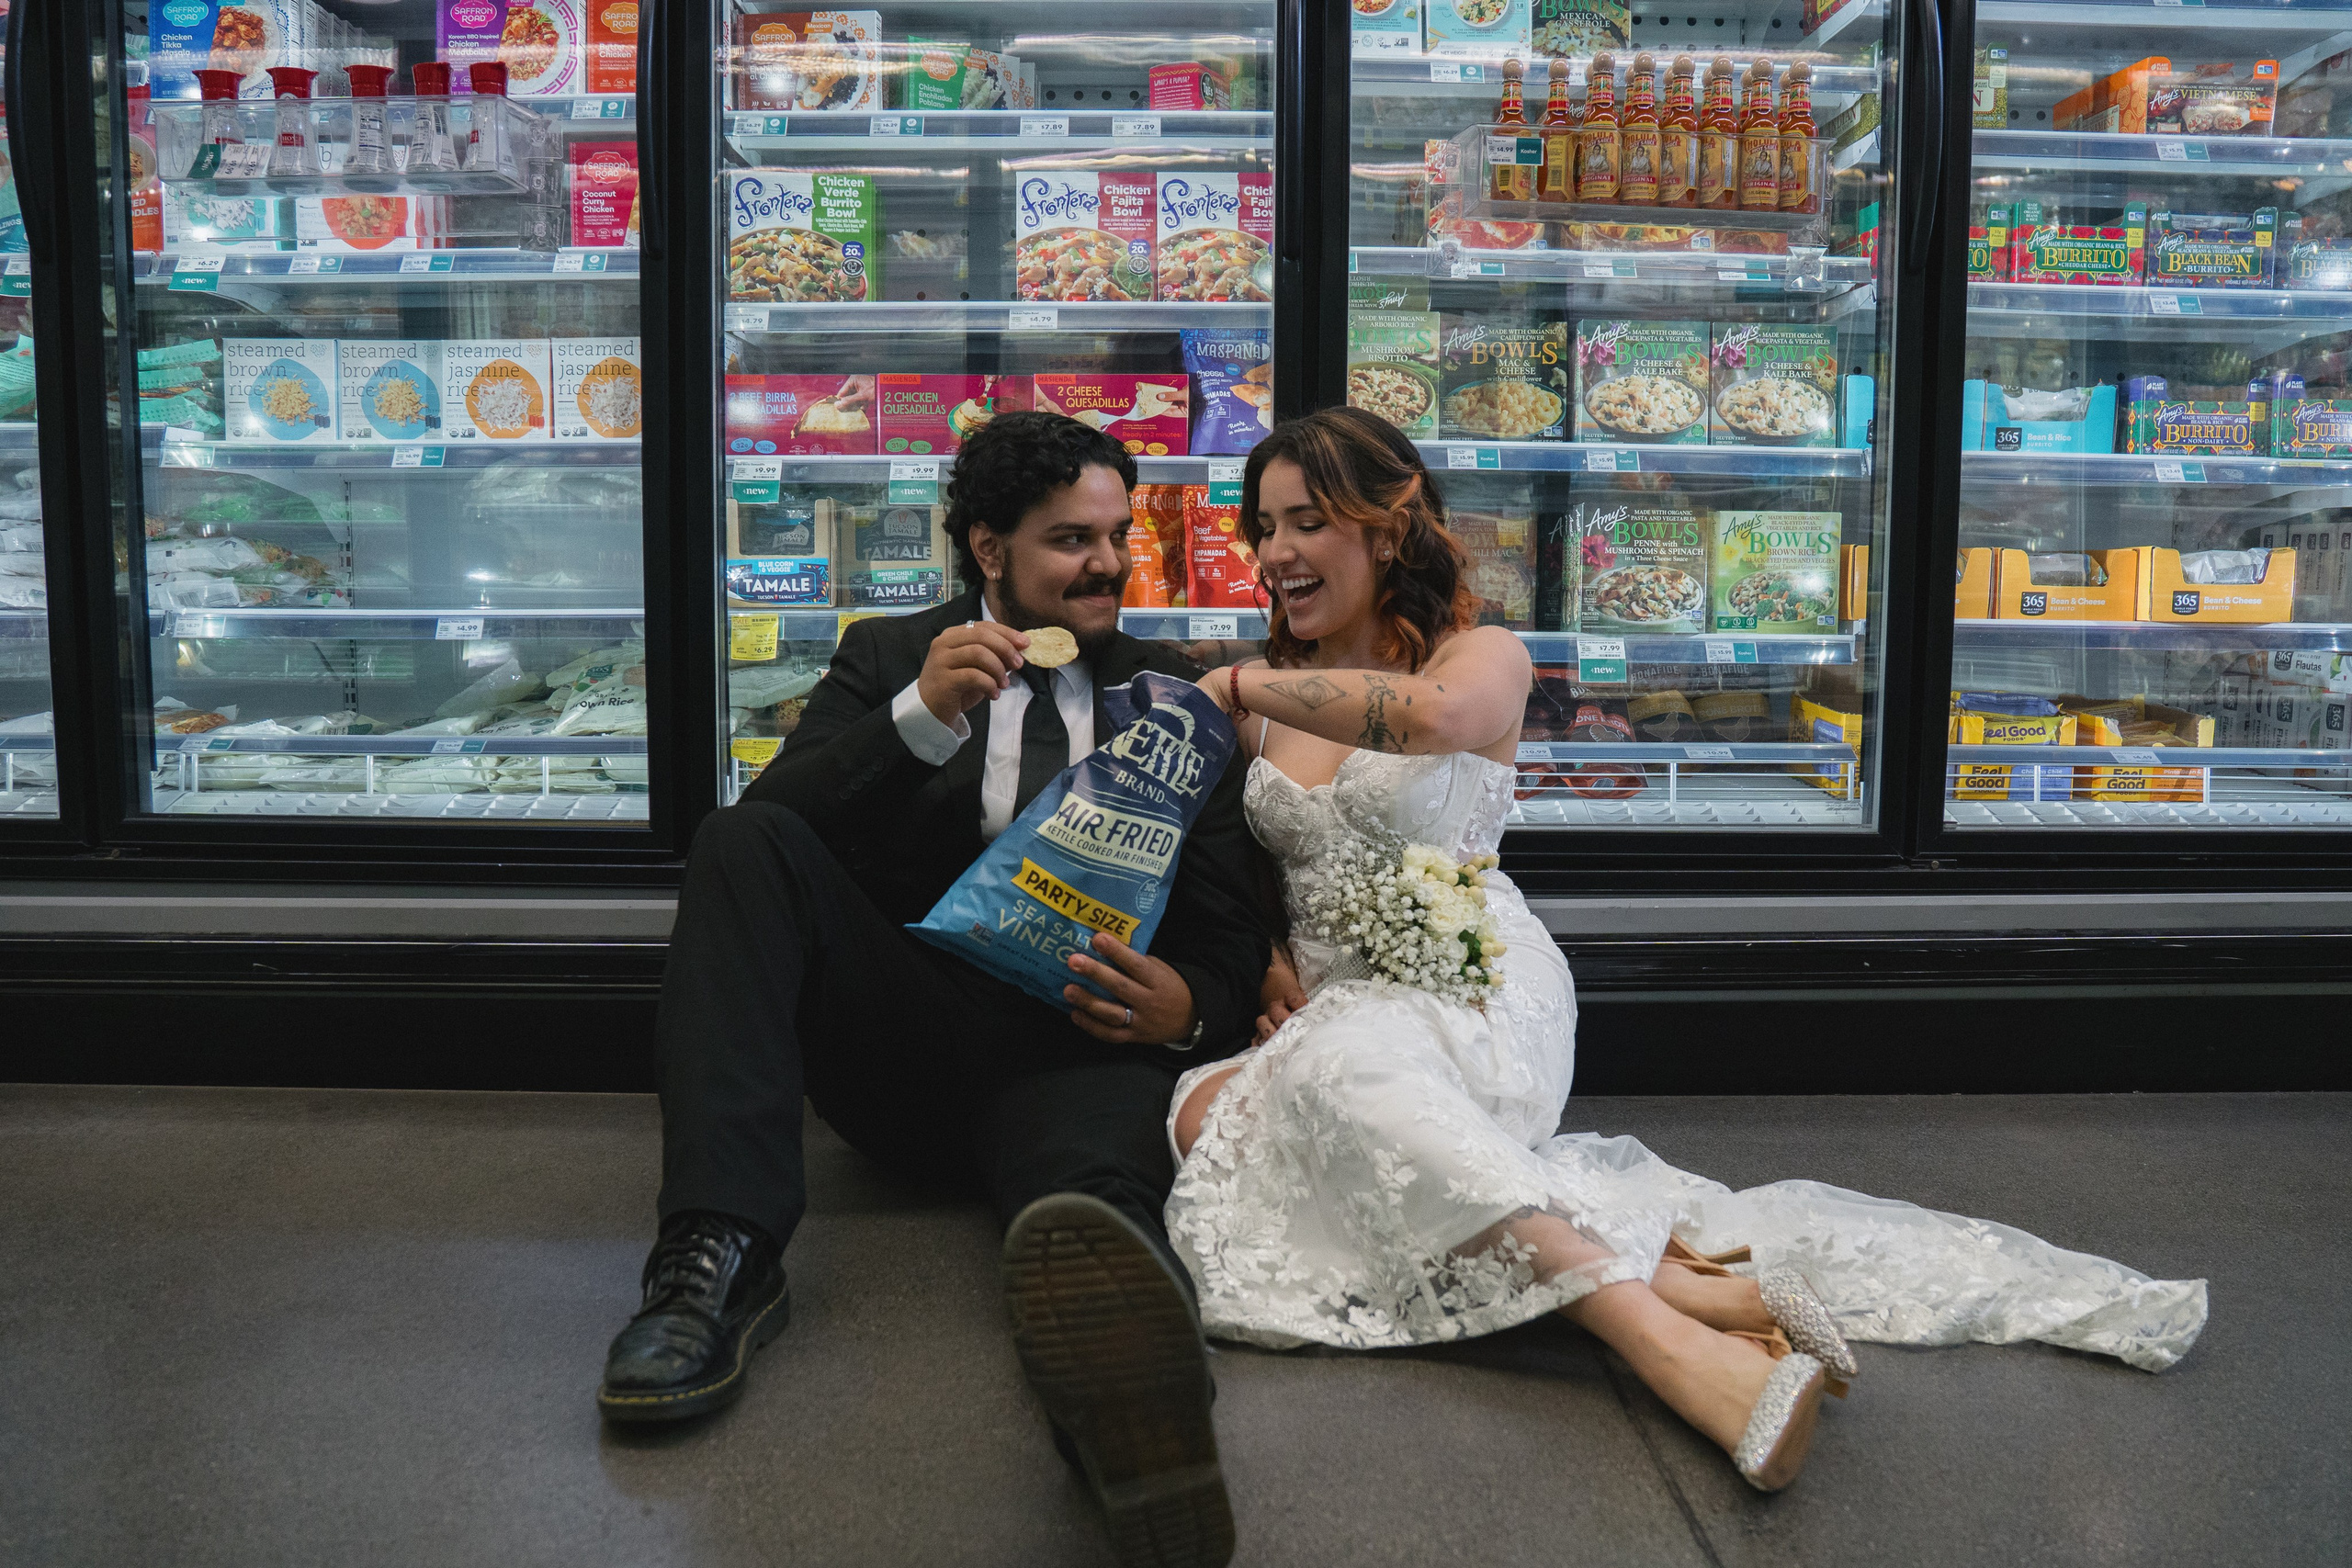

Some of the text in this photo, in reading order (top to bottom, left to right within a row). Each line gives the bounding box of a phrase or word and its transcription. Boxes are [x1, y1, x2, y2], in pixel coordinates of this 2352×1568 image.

[166, 6, 205, 15] SAFFRON
[455, 6, 493, 15] SAFFRON
[755, 33, 793, 41] SAFFRON
[923, 60, 956, 68] SAFFRON
[930, 67, 949, 75] ROAD
[919, 84, 944, 94] Chicken
[919, 92, 953, 103] Enchiladas
[2150, 88, 2181, 110] Amy's
[2181, 90, 2256, 100] VIETNAMESE
[919, 99, 944, 108] Poblano
[594, 170, 618, 178] ROAD
[819, 176, 865, 187] Chicken
[824, 187, 859, 197] Verde
[1104, 186, 1150, 195] Chicken
[821, 197, 862, 208] Burrito
[1111, 196, 1143, 207] Fajita
[827, 208, 856, 218] Bowl
[1113, 207, 1141, 217] Bowl
[2030, 230, 2056, 249] Amy's
[2157, 234, 2185, 254] Amy's
[2041, 248, 2125, 268] BURRITO
[2168, 254, 2251, 273] BLACK BEAN
[1443, 325, 1486, 356] Amy's
[1588, 322, 1629, 354] Amy's
[228, 342, 305, 357] steamed
[447, 343, 522, 358] steamed
[1470, 342, 1557, 365] BOWLS
[1615, 342, 1700, 366] BOWLS
[230, 361, 287, 377] brown
[449, 362, 520, 381] jasmine
[229, 381, 263, 396] rice
[447, 381, 480, 397] rice
[1057, 386, 1102, 397] 2 CHEESE
[885, 392, 938, 402] 2 CHICKEN
[1066, 397, 1129, 408] QUESADILLAS
[884, 404, 945, 414] QUESADILLAS
[2157, 407, 2183, 424] Amy's
[1997, 432, 2019, 443] 365
[2165, 423, 2246, 443] BURRITO
[746, 487, 765, 495] new
[1585, 505, 1628, 536] Amy's
[1194, 526, 1211, 535] Beef
[1611, 523, 1698, 546] BOWLS
[1722, 514, 1762, 544] Amy's
[1747, 532, 1832, 554] BOWLS
[1668, 547, 1703, 556] SPINACH
[742, 578, 810, 592] TAMALE
[865, 584, 926, 598] TAMALE
[2022, 595, 2044, 607] 365
[2051, 597, 2069, 605] Bean
[2078, 598, 2106, 606] Cheese
[1594, 666, 1613, 674] new
[2296, 660, 2322, 671] Flautas
[608, 697, 634, 705] Rice
[2008, 726, 2046, 736] Good
[1114, 770, 1165, 803] BRAND
[2108, 779, 2145, 789] Good
[1057, 802, 1174, 858] AIR FRIED
[1046, 824, 1164, 871] KETTLE COOKED AIR FINISHED
[1024, 870, 1129, 936] PARTY SIZE
[1012, 898, 1091, 951] SEA SALT
